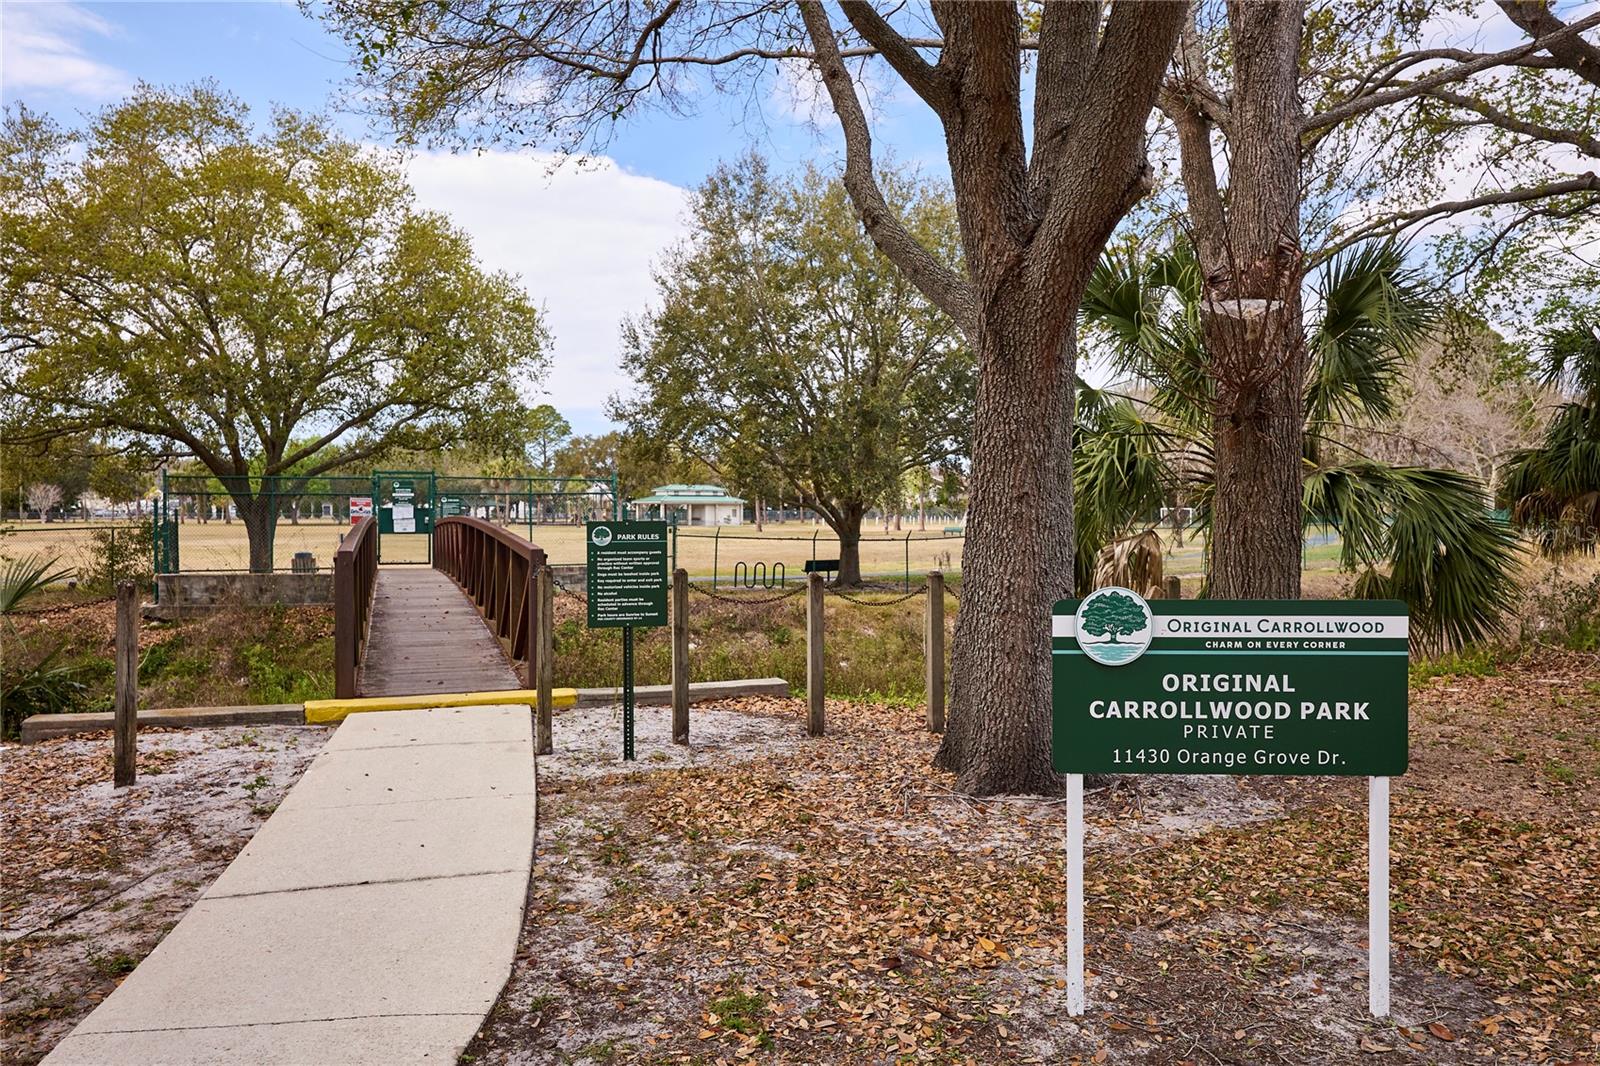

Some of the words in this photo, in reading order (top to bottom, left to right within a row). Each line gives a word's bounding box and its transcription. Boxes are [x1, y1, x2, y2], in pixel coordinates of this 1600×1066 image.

[1205, 641, 1242, 649] CHARM
[1303, 641, 1346, 649] CORNER
[1162, 673, 1296, 693] ORIGINAL
[1089, 700, 1291, 720] CARROLLWOOD
[1300, 702, 1370, 720] PARK
[1183, 725, 1274, 738] PRIVATE
[1113, 749, 1170, 764] 11430
[1177, 749, 1247, 768] Orange
[1254, 750, 1310, 765] Grove
[1318, 750, 1346, 765] Dr.
